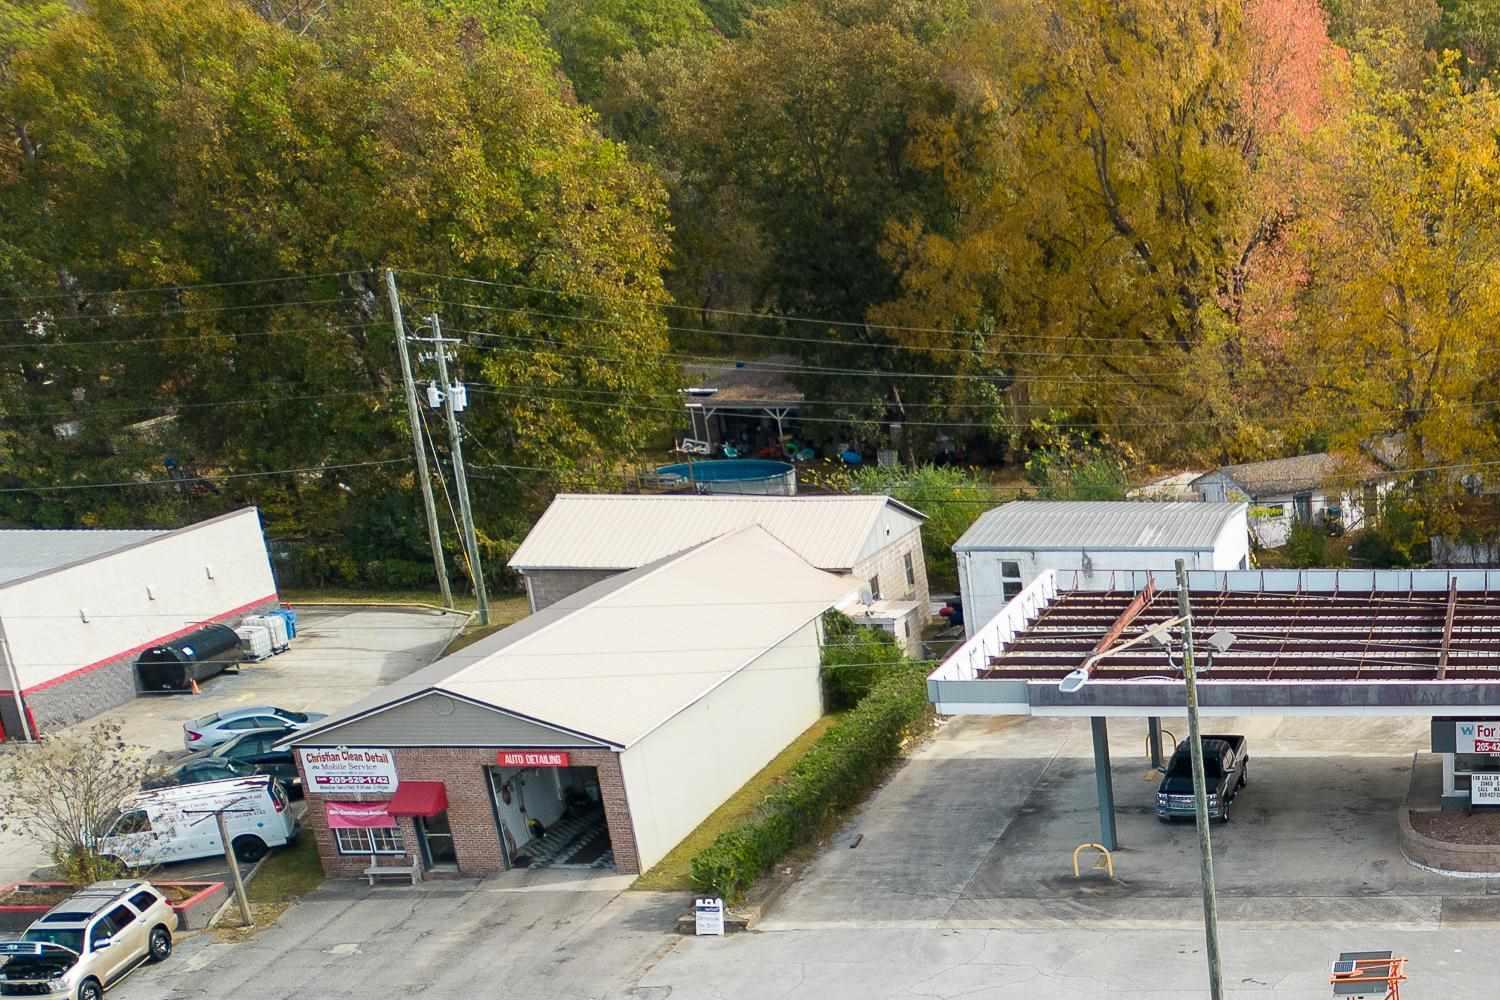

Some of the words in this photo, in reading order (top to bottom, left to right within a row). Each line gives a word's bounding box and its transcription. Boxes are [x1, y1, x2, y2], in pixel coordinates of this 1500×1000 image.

[1477, 725, 1496, 738] For
[306, 751, 340, 764] Christian
[342, 751, 363, 761] Clean
[365, 752, 389, 764] Detail
[505, 754, 523, 764] AUTO
[525, 754, 561, 765] DETAILING
